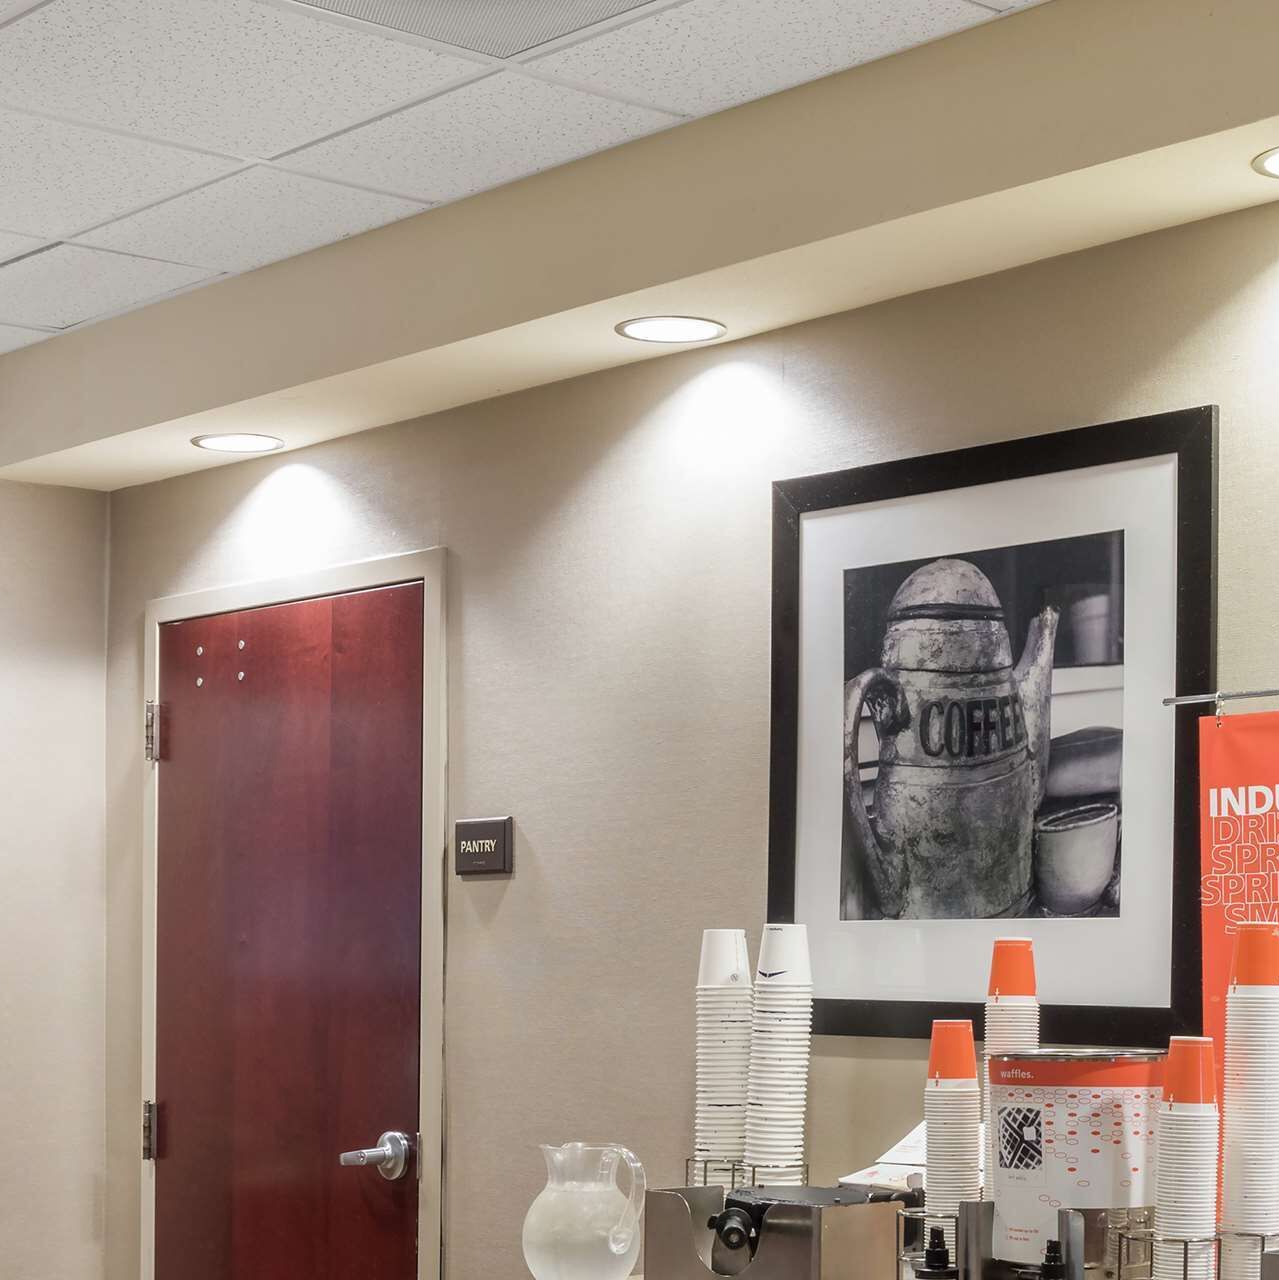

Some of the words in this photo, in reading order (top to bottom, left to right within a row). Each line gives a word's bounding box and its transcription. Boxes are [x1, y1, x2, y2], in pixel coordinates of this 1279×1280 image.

[920, 696, 1025, 758] COFFEE
[460, 840, 496, 853] PANTRY
[1001, 1069, 1034, 1079] waffles.
